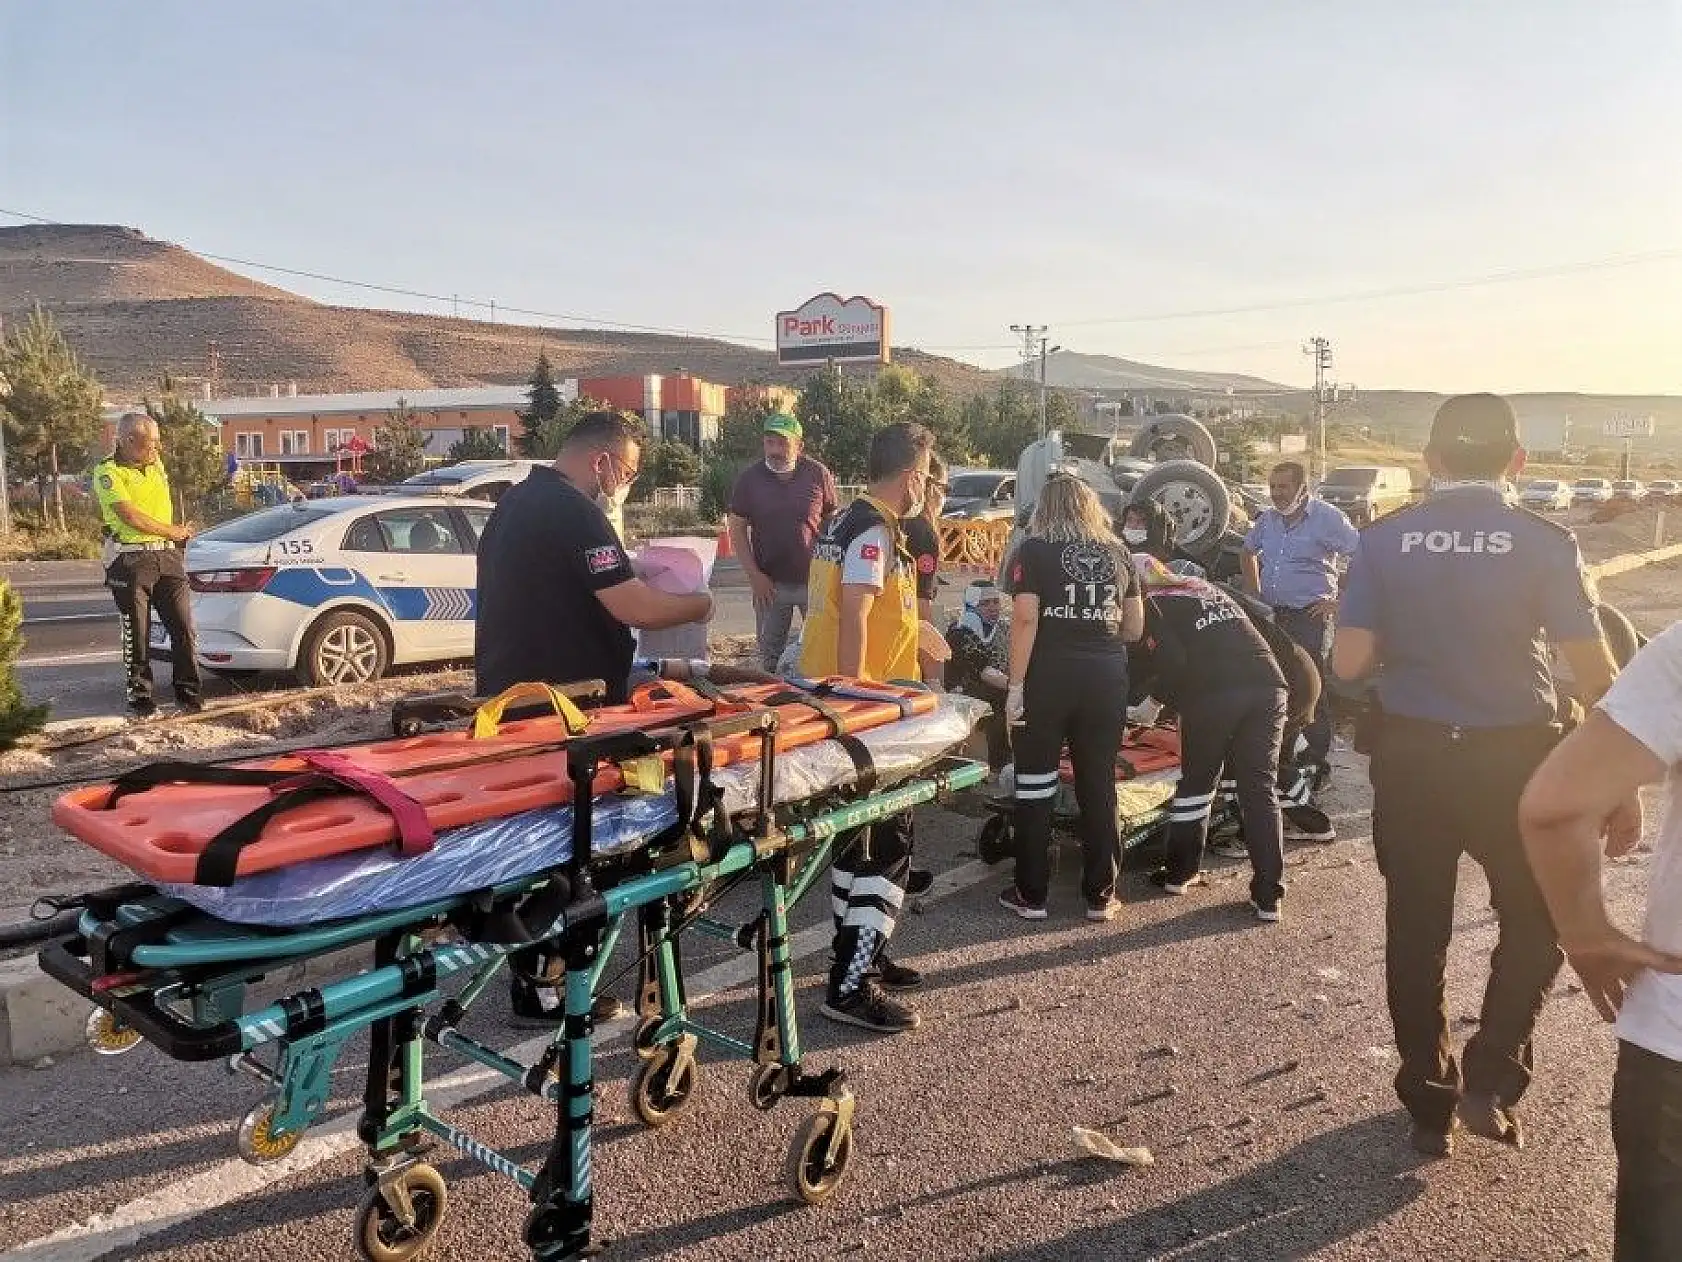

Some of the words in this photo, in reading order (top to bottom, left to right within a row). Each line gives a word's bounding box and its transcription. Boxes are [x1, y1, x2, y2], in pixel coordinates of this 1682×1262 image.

[784, 315, 835, 336] Park
[279, 539, 314, 555] 155
[1065, 583, 1117, 606] 112
